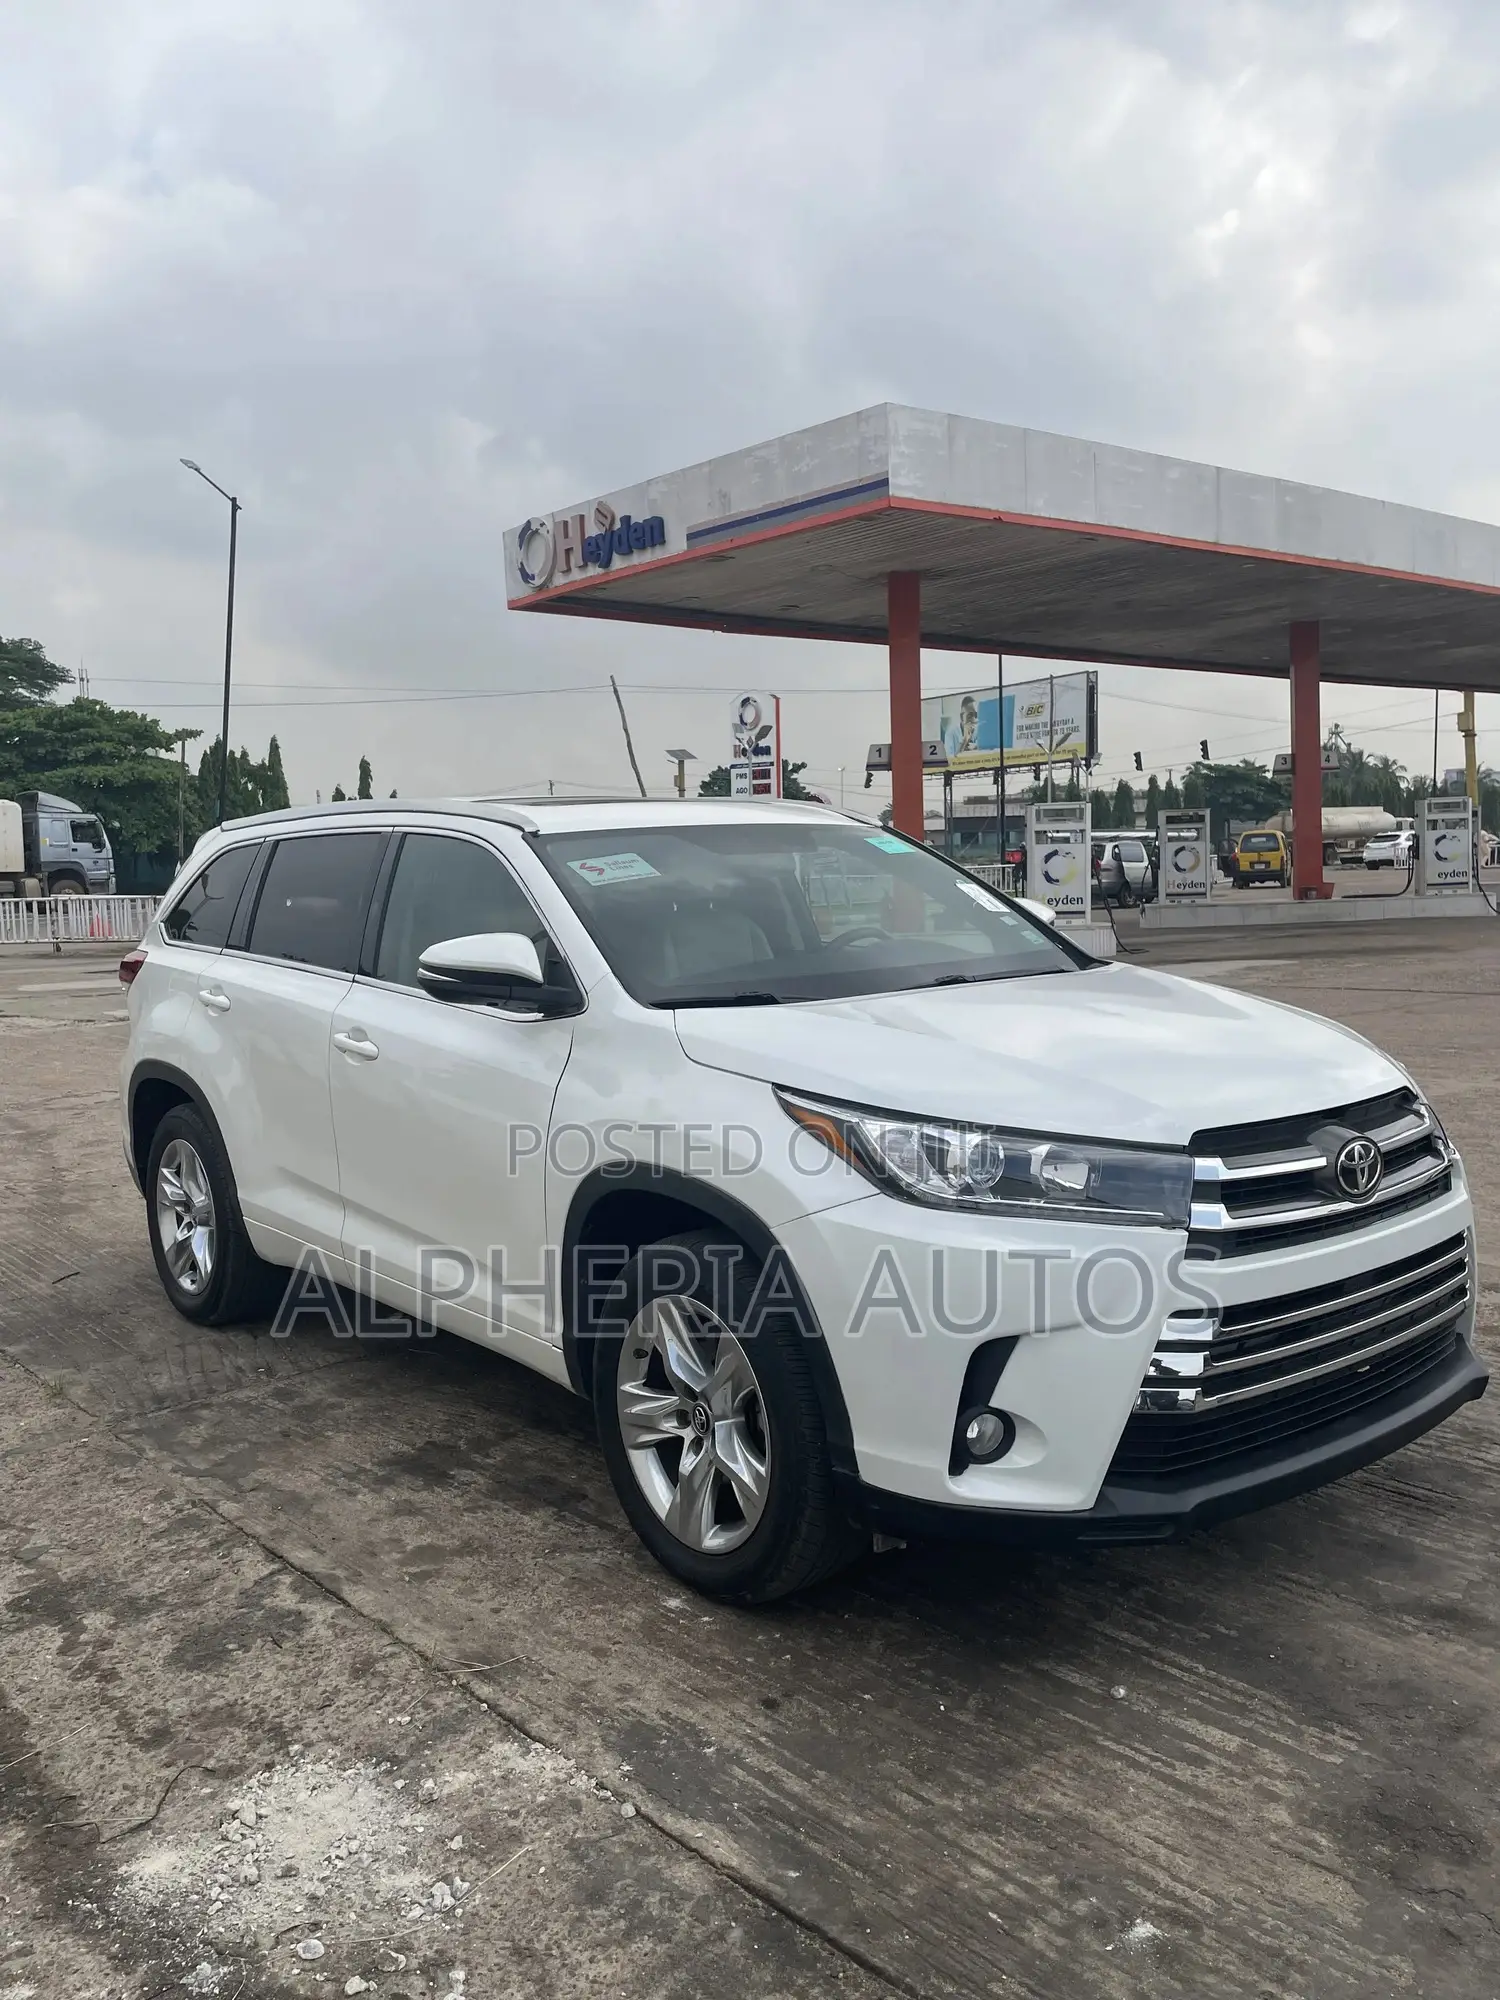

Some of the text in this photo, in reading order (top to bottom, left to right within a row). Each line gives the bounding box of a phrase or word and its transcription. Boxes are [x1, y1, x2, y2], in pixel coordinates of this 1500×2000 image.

[554, 513, 666, 573] Heyden
[1026, 704, 1043, 715] BIC
[876, 748, 882, 758] 1
[929, 744, 938, 756] 2
[1281, 756, 1288, 766] 3
[1324, 754, 1331, 764] 4
[735, 772, 748, 780] PMS
[735, 787, 748, 795] AGO
[1167, 879, 1206, 891] Heyden
